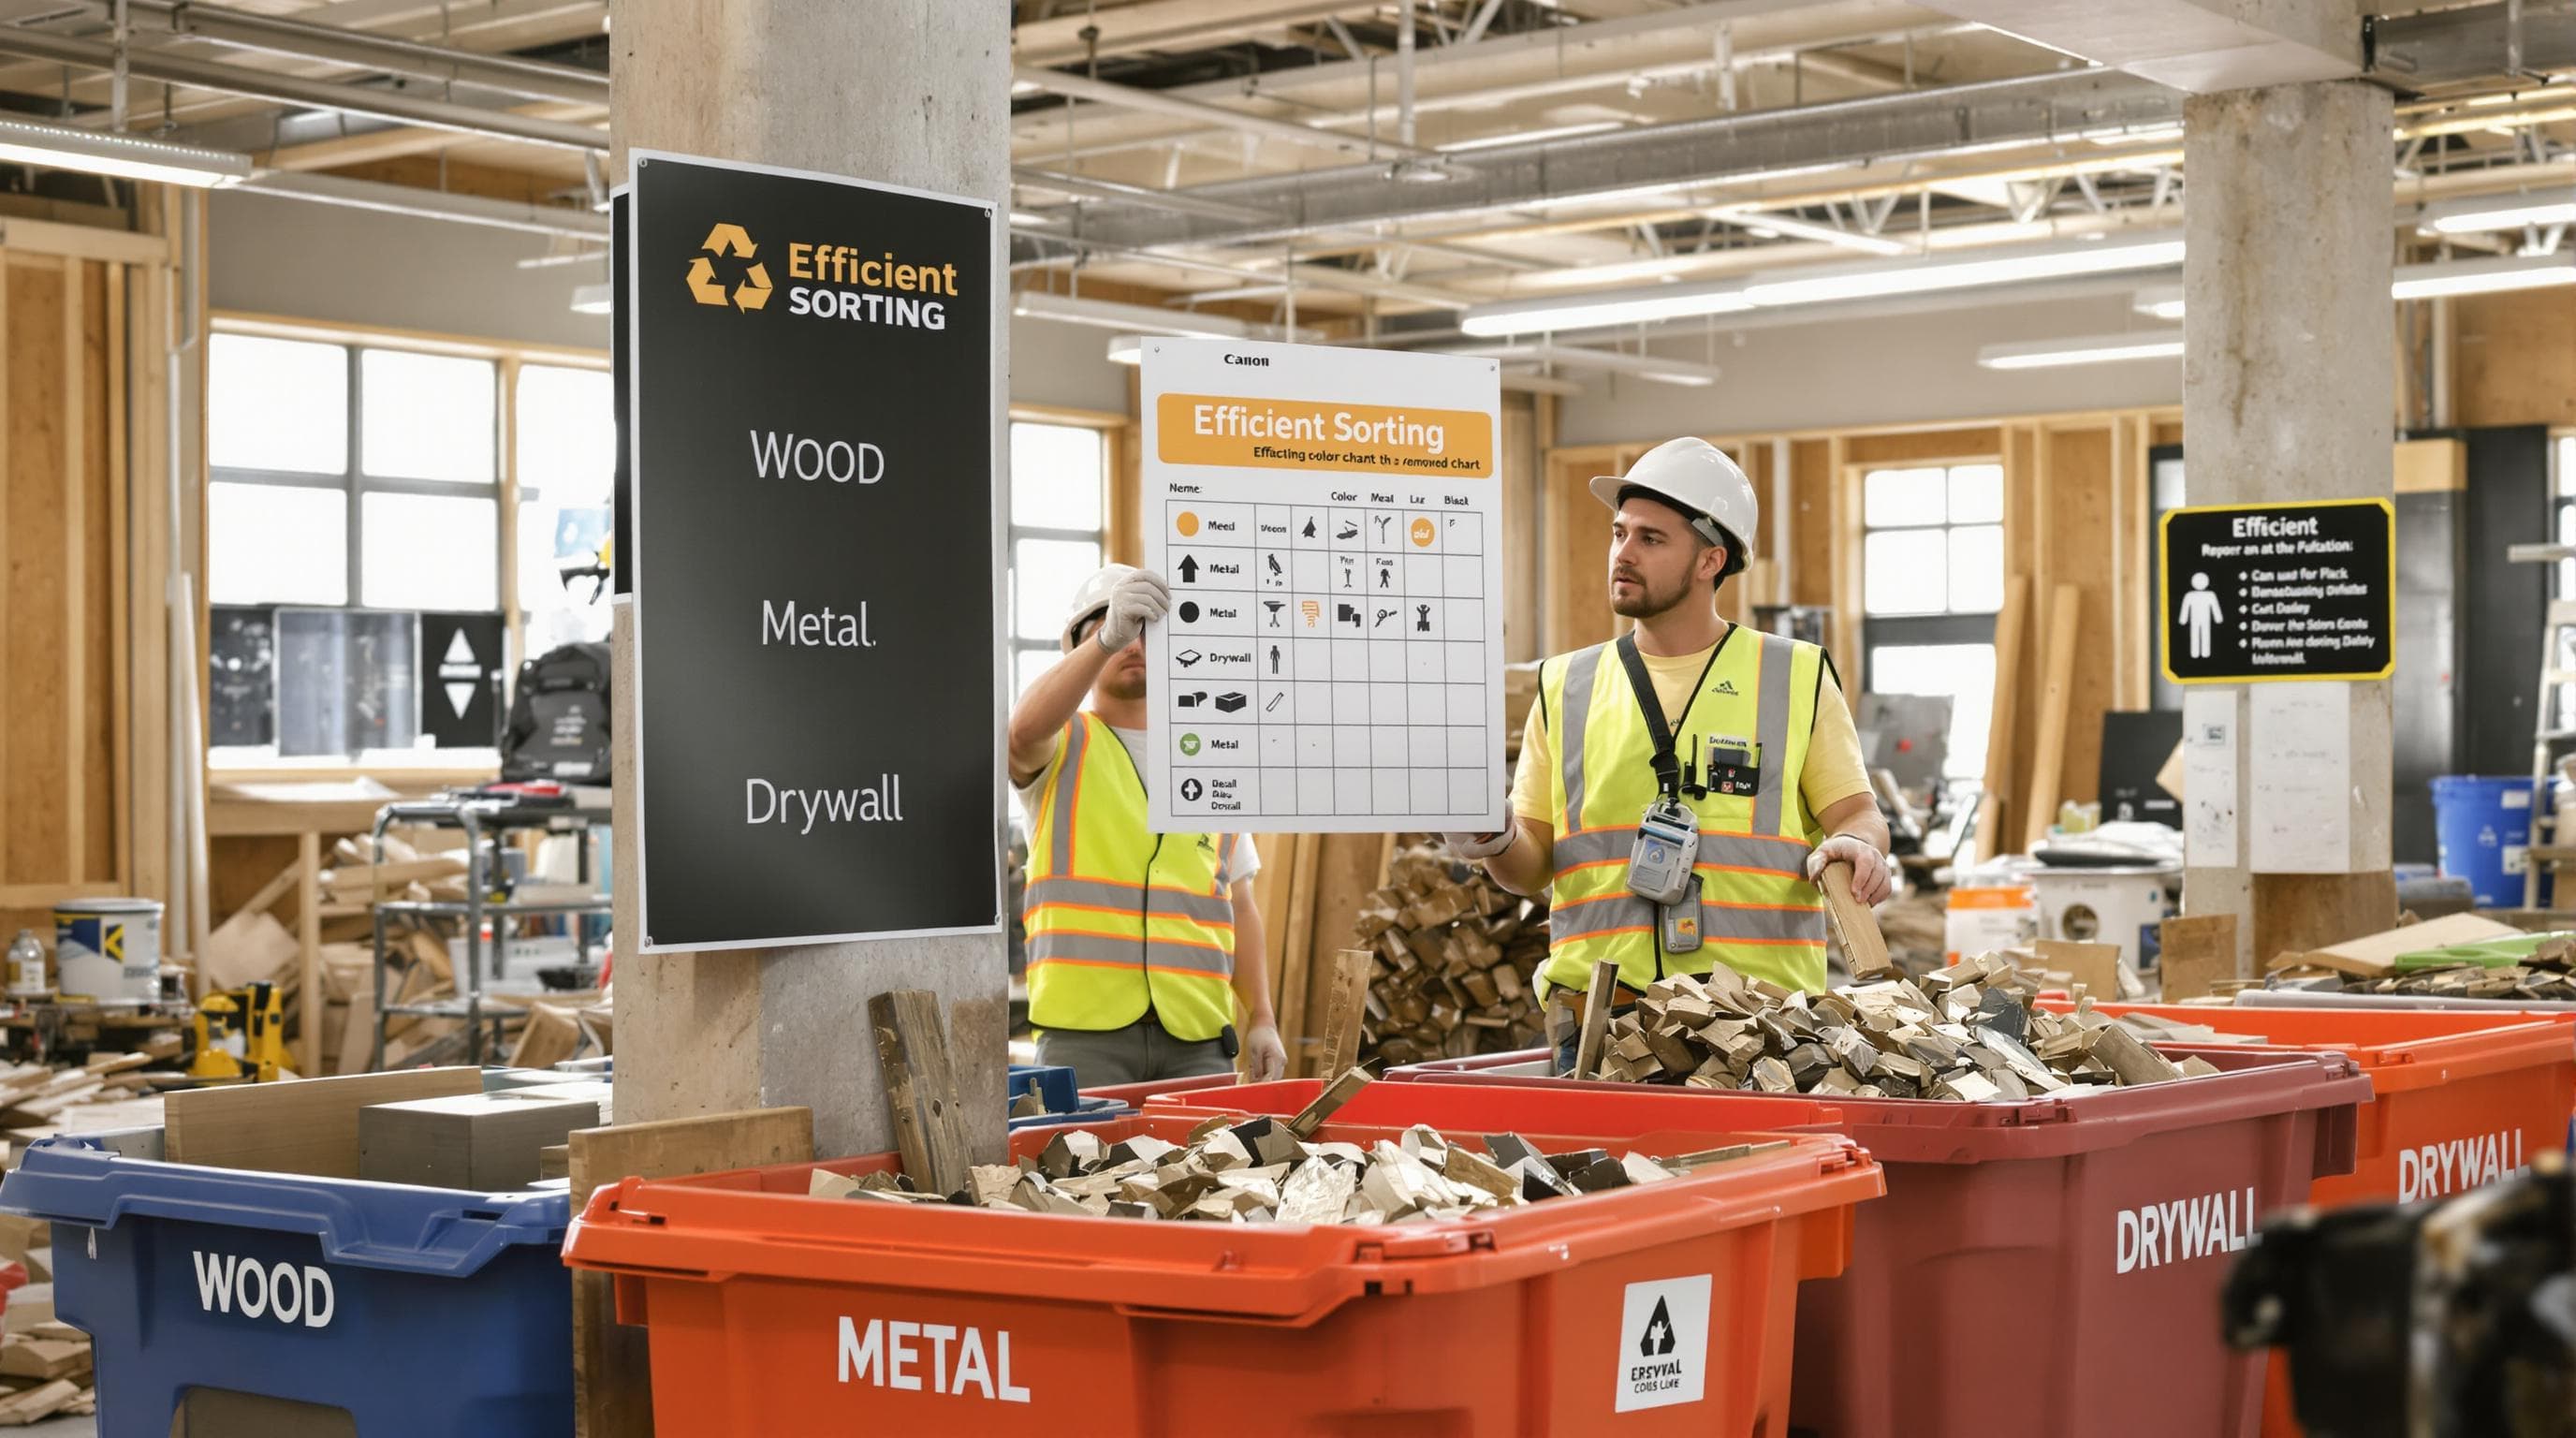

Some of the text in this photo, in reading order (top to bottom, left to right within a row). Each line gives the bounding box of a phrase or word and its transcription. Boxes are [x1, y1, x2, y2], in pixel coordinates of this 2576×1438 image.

[788, 242, 959, 298] Efficient
[788, 286, 946, 330] SORTING
[1223, 354, 1270, 367] Canon
[1193, 404, 1445, 454] Efficient Sorting
[750, 429, 886, 486] WOOD
[1451, 458, 1482, 470] chart
[1331, 492, 1358, 502] Color
[2232, 516, 2319, 538] Efficient
[1209, 653, 1251, 666] Drywall
[1210, 740, 1239, 750] Metal
[744, 774, 904, 835] Drywall
[2398, 1128, 2531, 1205] DRYWALL
[2116, 1186, 2263, 1274] DRYWALL
[192, 1250, 335, 1328] WOOD
[838, 1315, 1031, 1403] METAL
